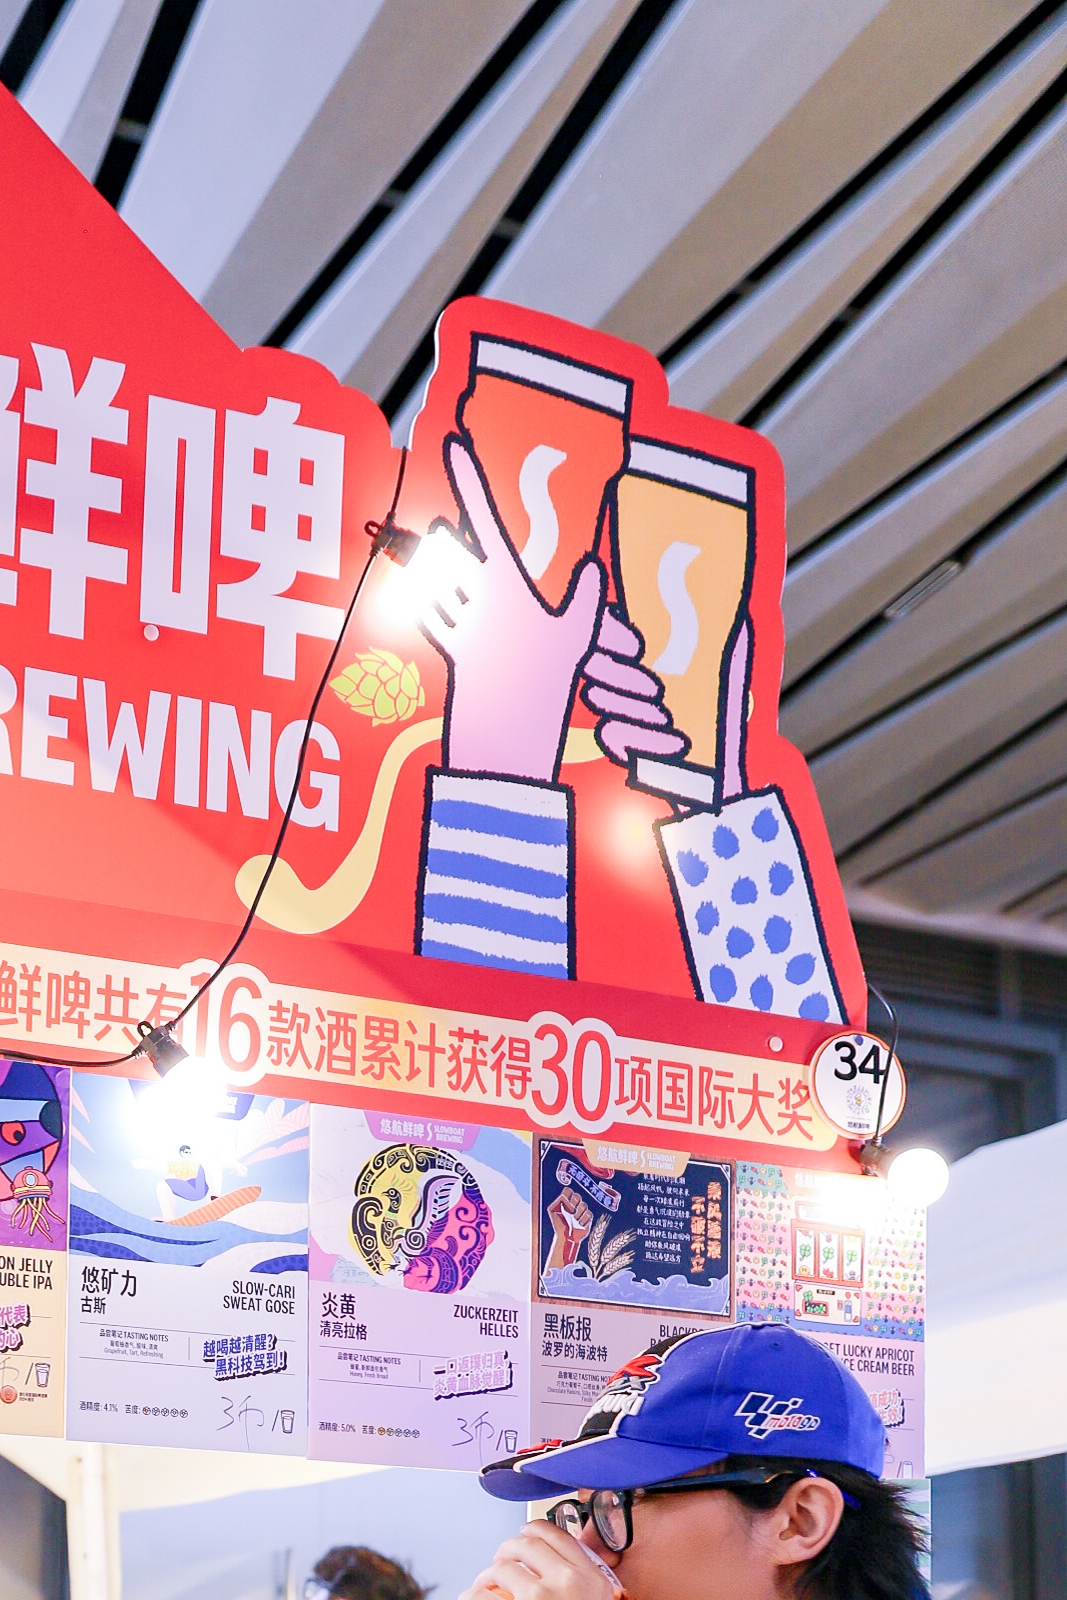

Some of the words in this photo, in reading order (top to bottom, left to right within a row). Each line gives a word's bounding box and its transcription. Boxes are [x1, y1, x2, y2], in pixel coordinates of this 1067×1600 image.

[834, 1041, 885, 1084] 34
[380, 1118, 425, 1141] 悠航鲜啤
[434, 1124, 466, 1136] SLOWBOAT
[435, 1132, 464, 1145] BREWING
[19, 1257, 54, 1274] JELLY
[33, 1274, 53, 1290] IPA
[81, 1265, 137, 1297] 悠矿力
[232, 1280, 295, 1299] SLOW-CARI
[80, 1296, 107, 1315] 古斯
[223, 1295, 261, 1312] SWEAT
[265, 1300, 295, 1315] GOSE
[322, 1292, 357, 1320] 炎黄
[453, 1304, 519, 1323] ZUCKERZEIT
[319, 1320, 368, 1341] 清亮拉格
[479, 1322, 519, 1339] HELLES
[543, 1313, 592, 1342] 黑板报
[202, 1333, 275, 1359] 越喝越清醒?
[542, 1340, 608, 1362] 波罗的海波特
[843, 1344, 873, 1359] LUCKY
[875, 1347, 915, 1362] APRICOT
[214, 1350, 285, 1376] 黑科技驾到!
[857, 1359, 889, 1375] CREAM
[891, 1362, 915, 1377] BEER
